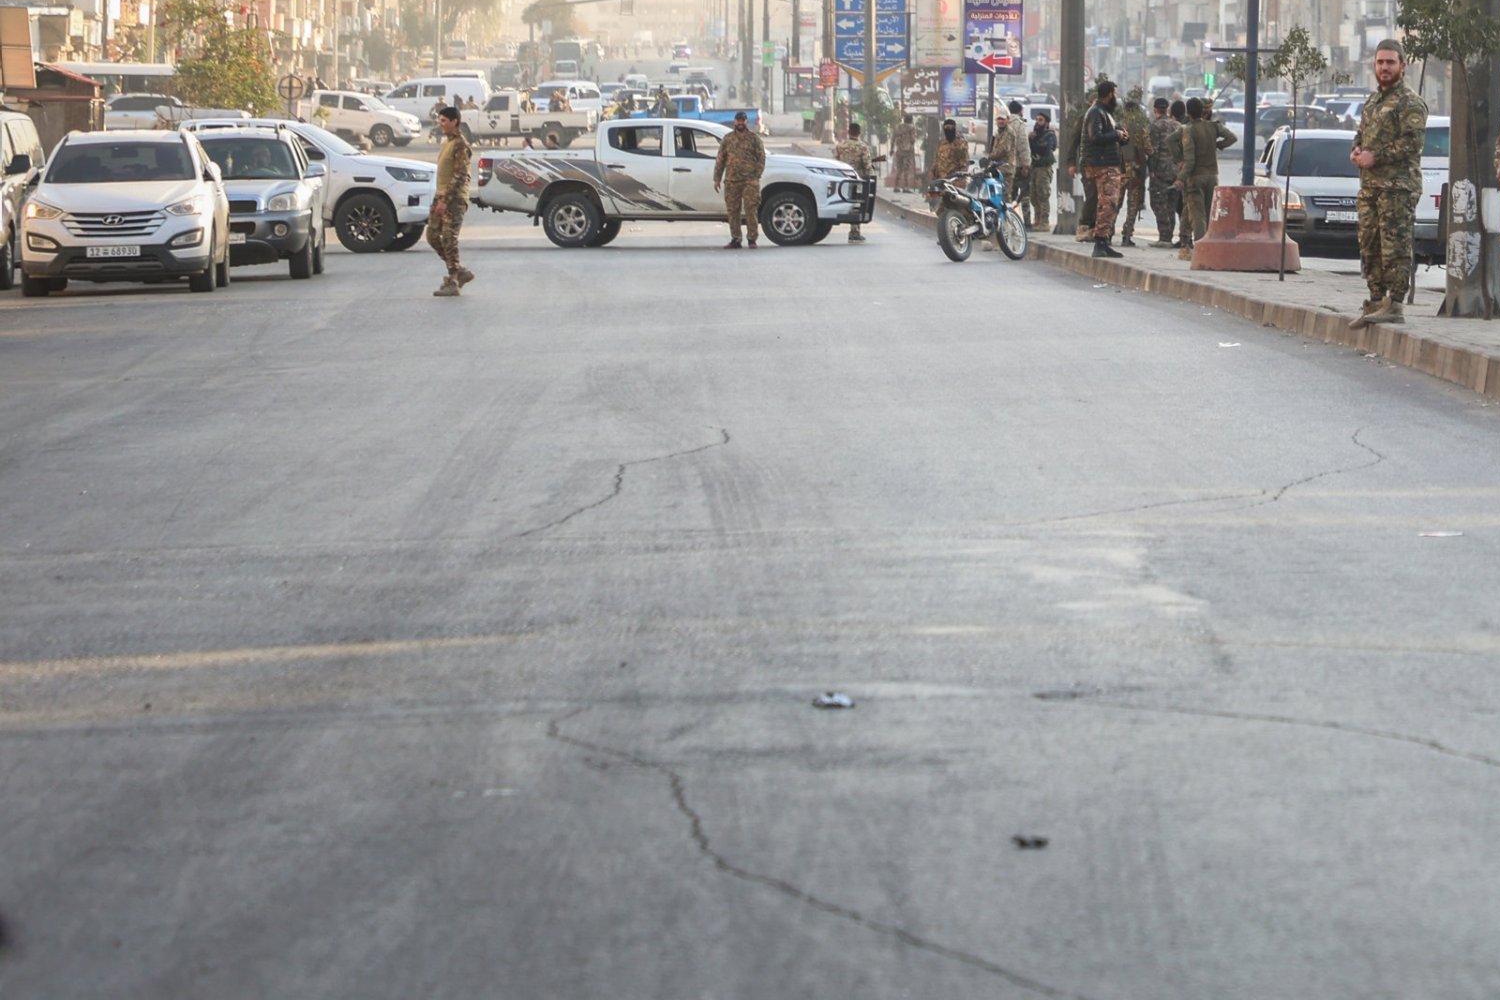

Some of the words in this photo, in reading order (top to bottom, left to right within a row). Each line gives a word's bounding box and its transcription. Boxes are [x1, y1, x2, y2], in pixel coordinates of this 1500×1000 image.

[970, 12, 993, 21] المنزلية
[914, 69, 939, 79] معرض
[903, 79, 939, 99] المرعي
